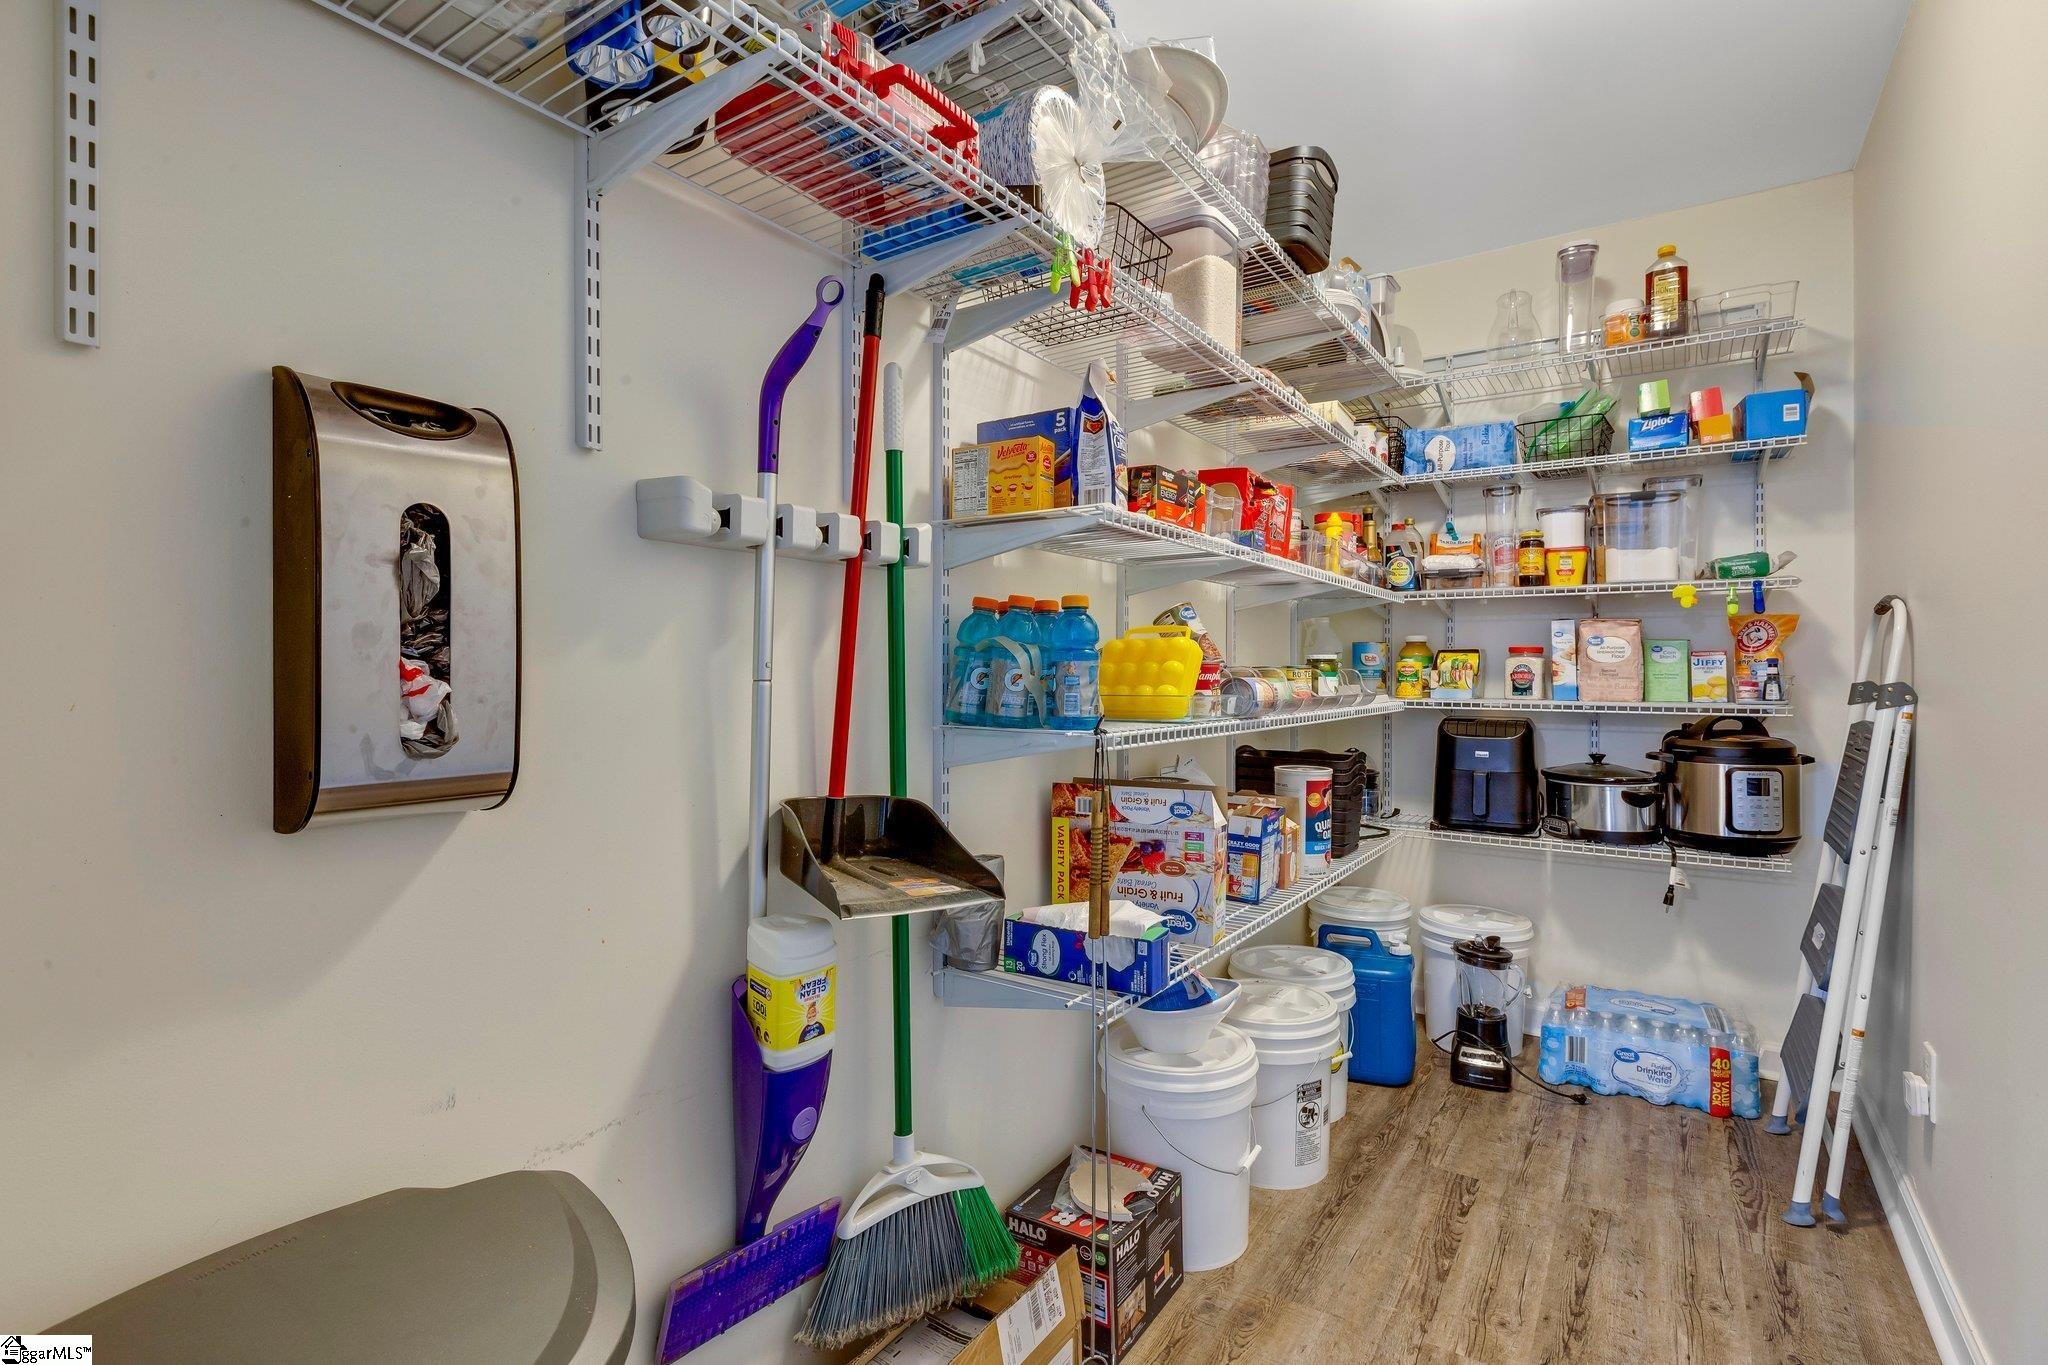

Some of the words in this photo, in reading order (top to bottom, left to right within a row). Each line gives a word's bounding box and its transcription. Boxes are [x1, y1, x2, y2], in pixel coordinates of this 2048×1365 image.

[1055, 411, 1066, 427] 5
[1641, 415, 1675, 432] Ziploc
[1054, 426, 1067, 434] pack
[997, 442, 1028, 459] Velveeta
[1693, 658, 1724, 666] JIFFY
[1120, 796, 1143, 805] Grain
[1143, 798, 1149, 806] &
[1150, 798, 1167, 806] Fruit
[1056, 824, 1065, 866] VARIETY
[1056, 869, 1065, 900] PACK
[1117, 878, 1133, 887] Bars
[1134, 879, 1157, 890] Cereal
[1116, 885, 1148, 899] Grain
[1149, 889, 1158, 900] &
[1159, 890, 1184, 903] Fruit
[1135, 900, 1160, 911] Variety
[1165, 918, 1193, 931] Great
[1005, 960, 1013, 969] 13
[1016, 961, 1023, 970] 20
[799, 977, 827, 991] FREAK
[800, 984, 827, 999] CLEAN
[1615, 1049, 1635, 1057] Great
[1711, 1058, 1730, 1070] 40
[1636, 1065, 1672, 1079] Drinking
[1647, 1074, 1672, 1085] Water
[1711, 1081, 1721, 1105] PACK
[1721, 1081, 1730, 1107] VALUE
[1008, 1217, 1047, 1242] HALO
[1116, 1229, 1140, 1262] HALO
